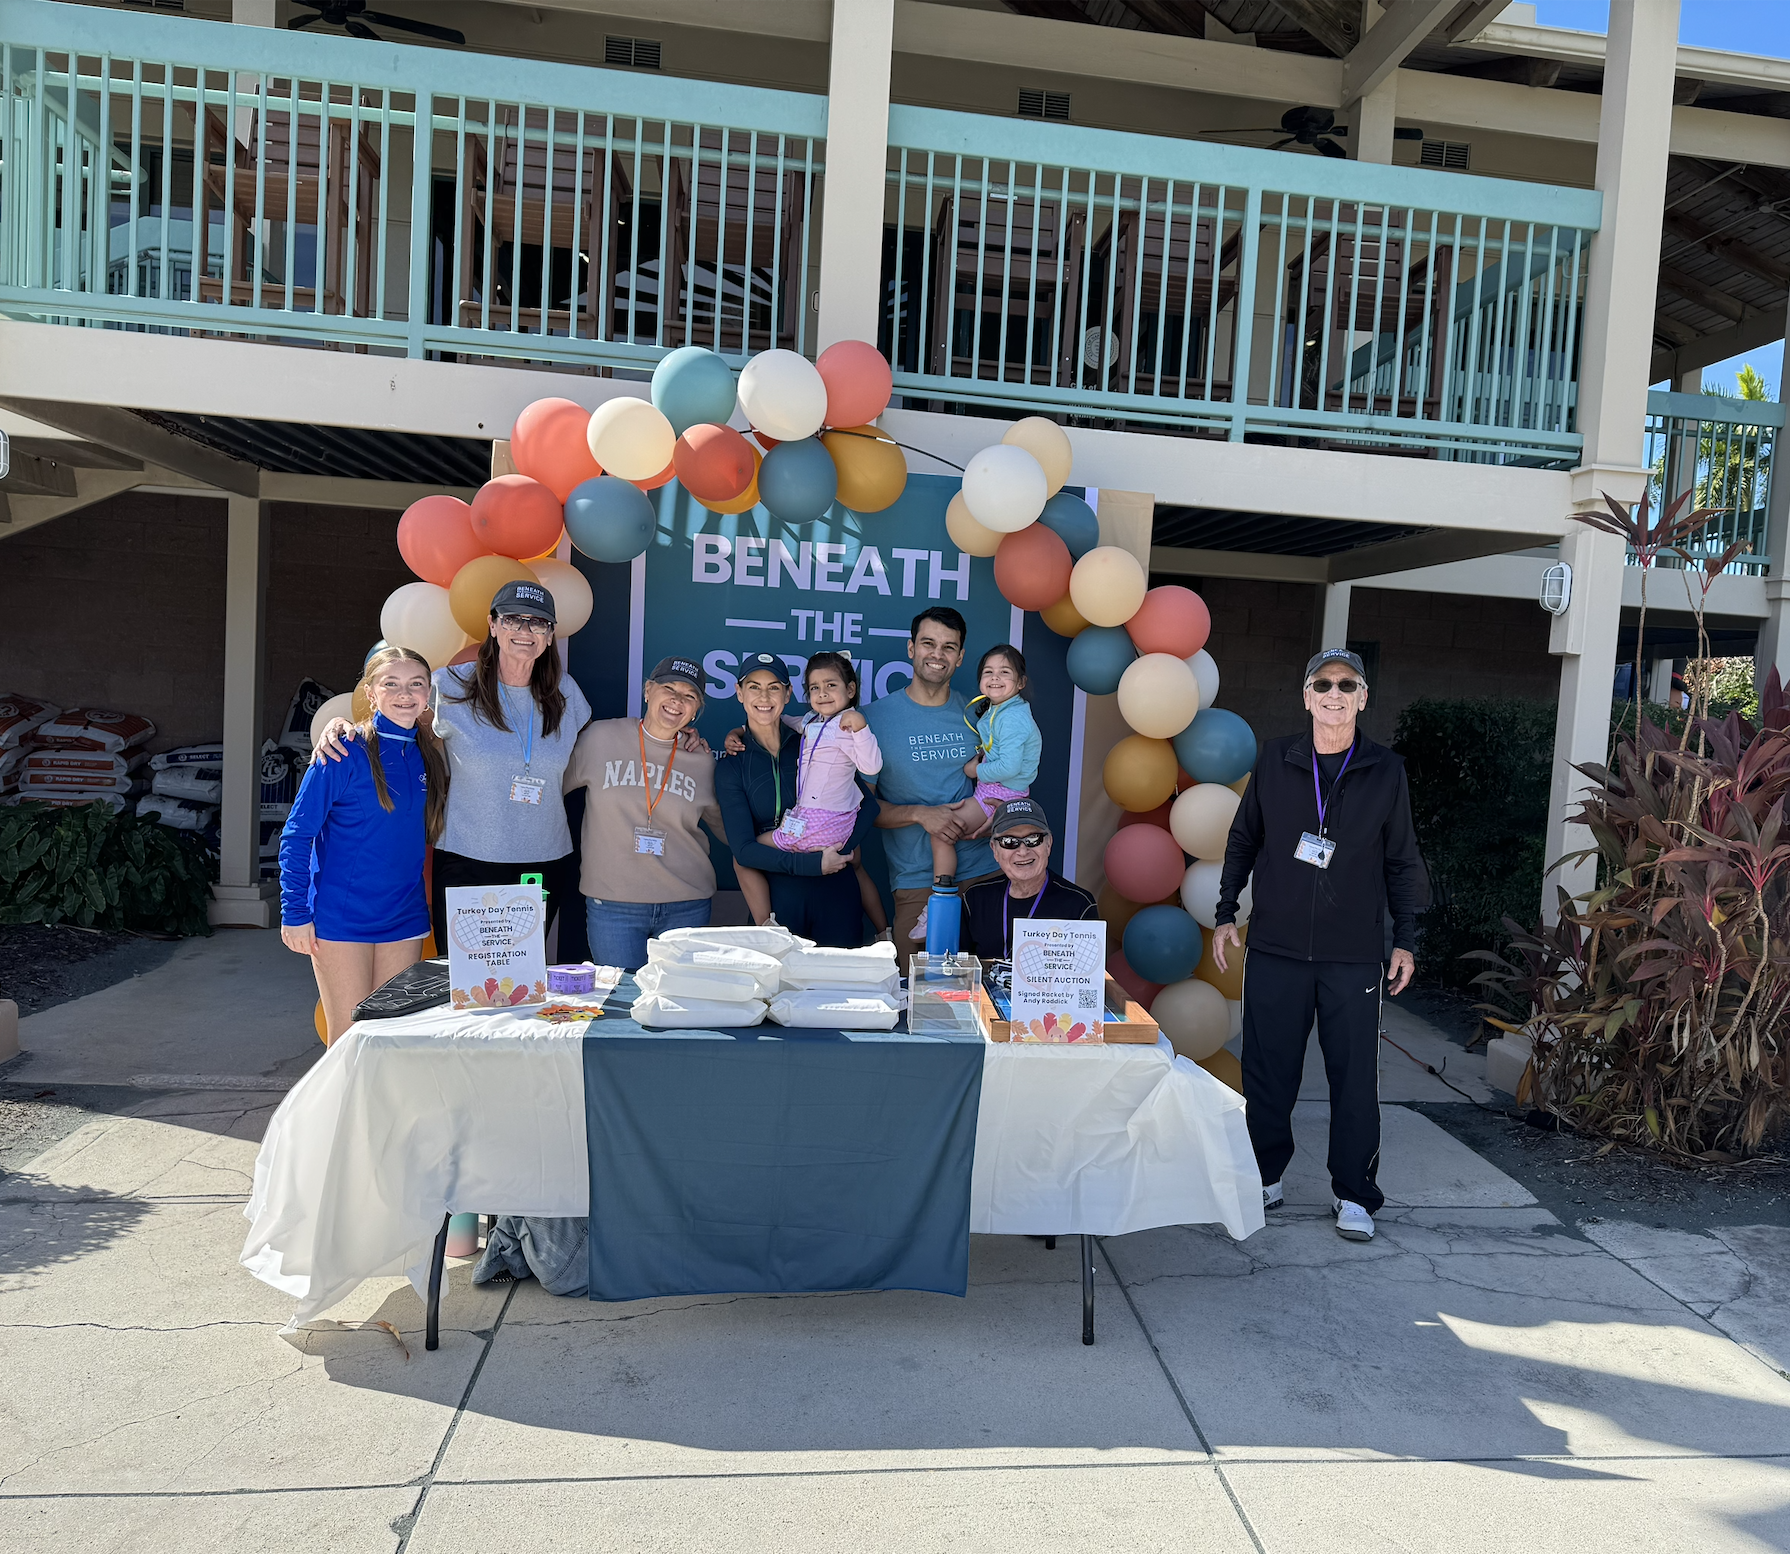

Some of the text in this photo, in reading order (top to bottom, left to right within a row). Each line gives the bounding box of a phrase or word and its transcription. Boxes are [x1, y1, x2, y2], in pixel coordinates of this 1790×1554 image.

[691, 533, 971, 601] BENEATH
[516, 586, 544, 596] BENEATH
[515, 592, 544, 604] SERVICE
[790, 608, 863, 644] THE
[908, 732, 964, 745] BENEATH
[911, 746, 967, 762] SERVICE
[602, 760, 697, 803] NAPLES
[488, 906, 505, 915] Day
[506, 905, 534, 913] Tennis
[479, 926, 513, 934] BENEATH
[1022, 931, 1097, 940] Turkey Day Tennis
[468, 950, 527, 960] REGISTRATION
[486, 959, 510, 967] TABLE
[1017, 990, 1041, 998] Signed
[1065, 991, 1075, 999] by
